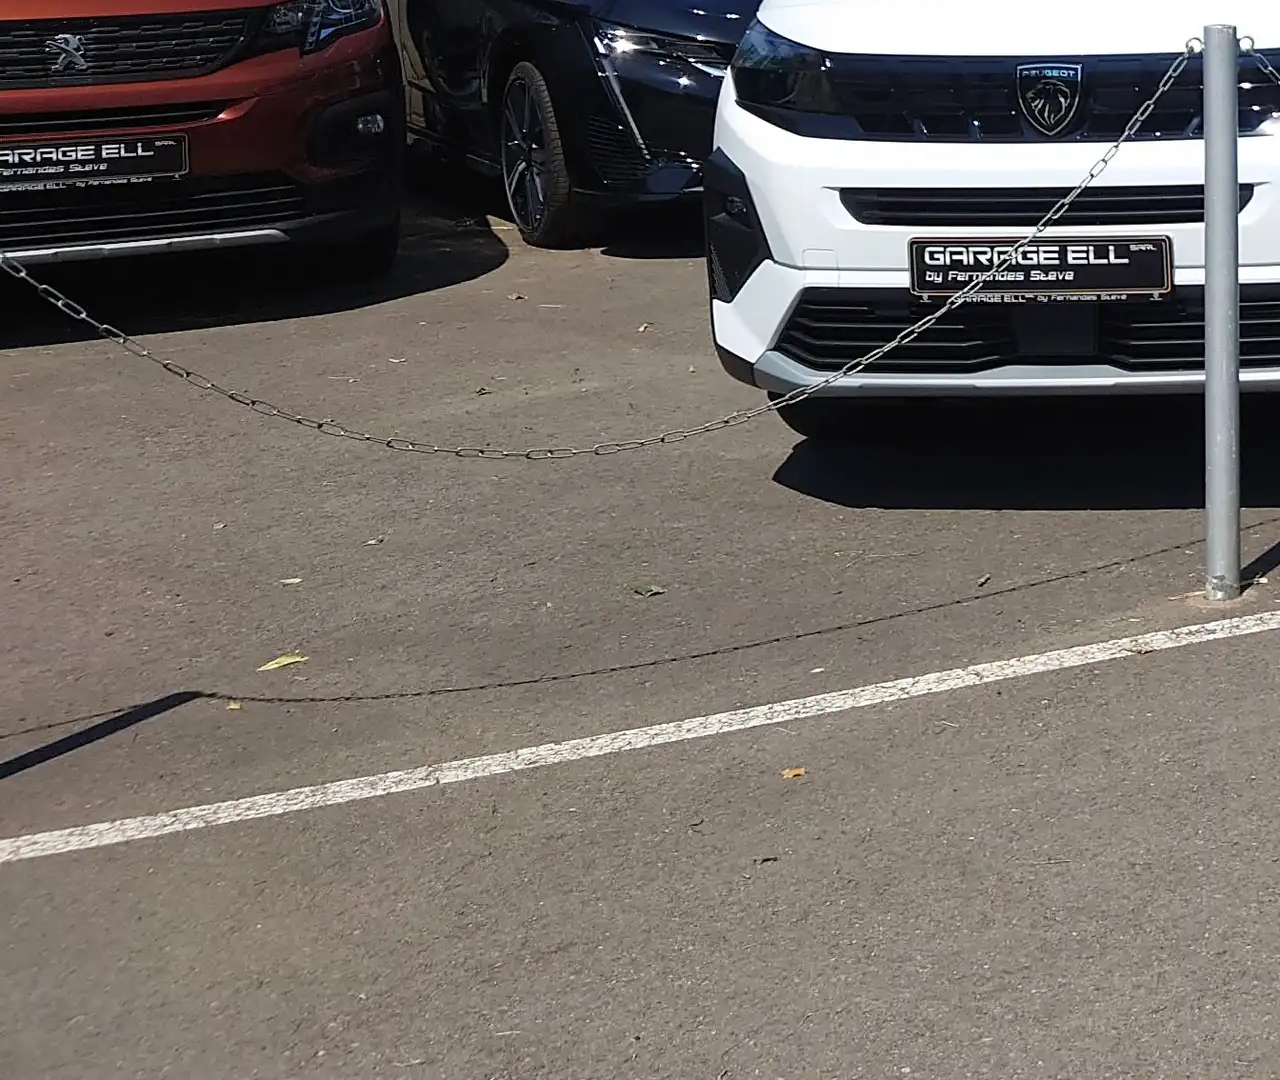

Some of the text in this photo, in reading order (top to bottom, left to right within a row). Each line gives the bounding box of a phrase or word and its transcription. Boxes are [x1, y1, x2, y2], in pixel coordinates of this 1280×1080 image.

[1022, 69, 1076, 77] PEUGEOT
[102, 143, 154, 158] ELL
[68, 163, 107, 172] Steve
[924, 246, 1060, 265] GARAGE
[1067, 246, 1129, 265] ELL
[925, 270, 1074, 283] by Fernandes Steve
[1004, 294, 1026, 303] ELL
[1037, 295, 1048, 303] by
[1100, 293, 1127, 301] Steve
